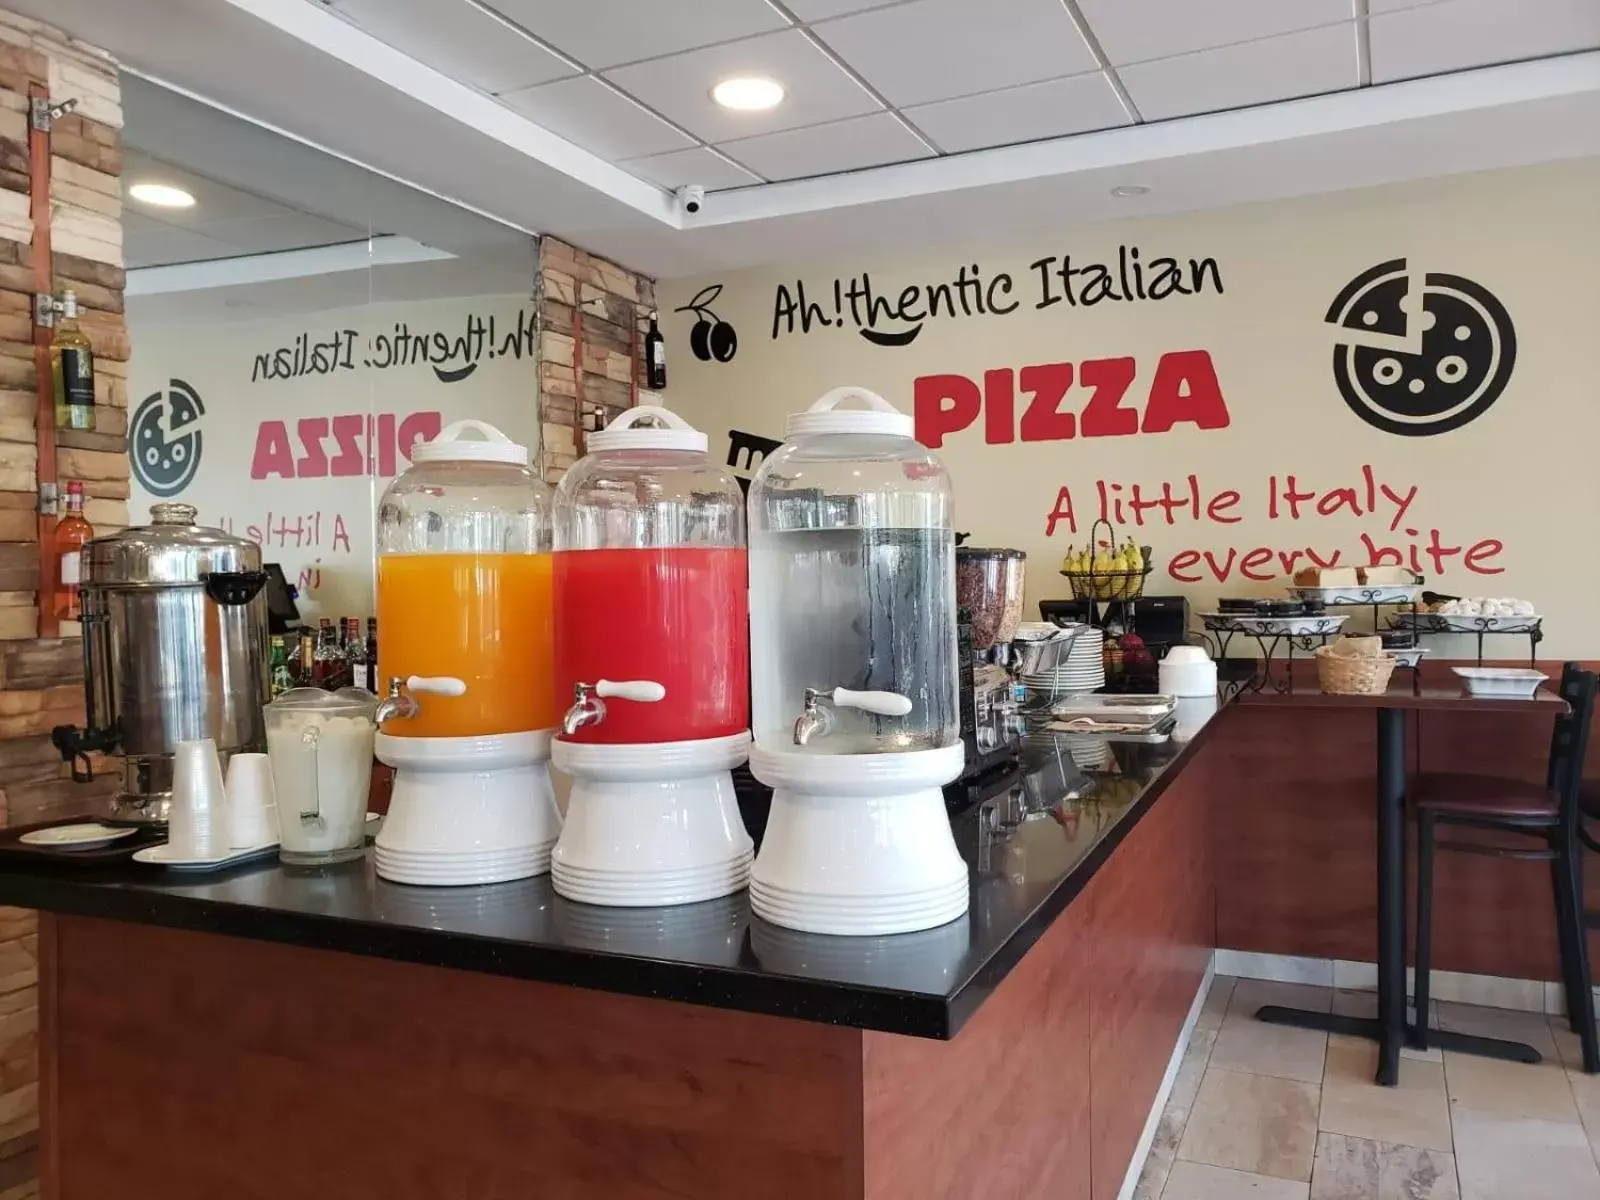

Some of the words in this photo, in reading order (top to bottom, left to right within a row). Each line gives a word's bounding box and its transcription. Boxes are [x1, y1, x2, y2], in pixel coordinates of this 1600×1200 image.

[771, 263, 1020, 340] Ah!thentic
[1029, 245, 1224, 310] Italian
[913, 350, 1230, 449] PIZZA
[1045, 484, 1077, 537] A
[1096, 474, 1243, 526] little
[1267, 464, 1418, 532] Italy
[1360, 527, 1506, 576] bite
